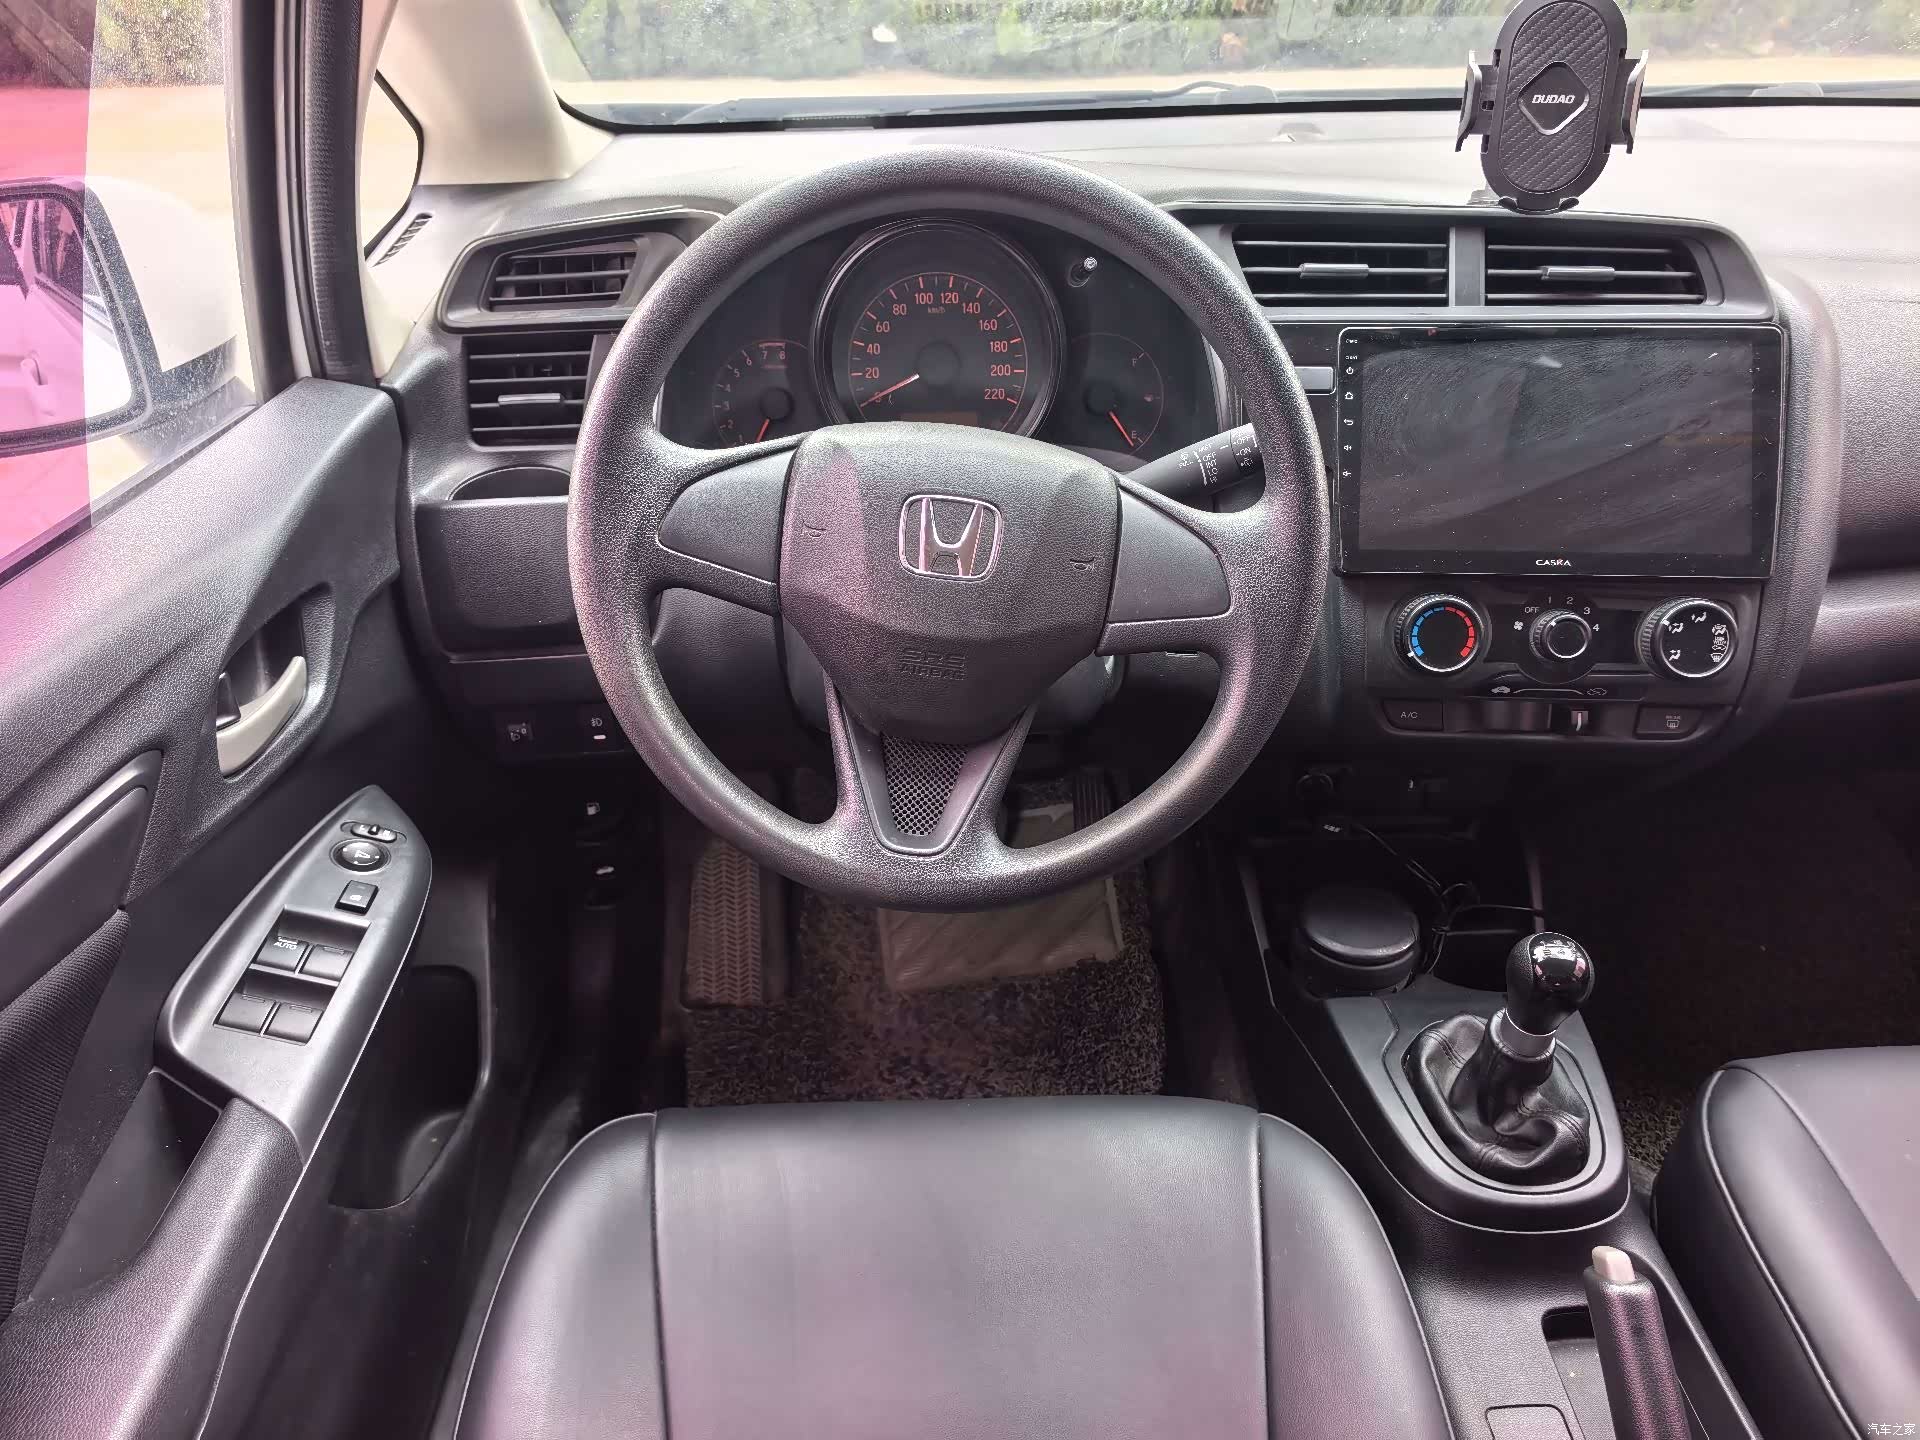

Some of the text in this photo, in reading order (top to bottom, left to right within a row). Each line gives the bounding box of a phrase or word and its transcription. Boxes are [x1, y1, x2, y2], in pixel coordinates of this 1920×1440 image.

[1531, 94, 1576, 104] DUDAO
[914, 292, 934, 305] 100
[940, 292, 959, 304] 120
[892, 303, 907, 316] 80
[962, 302, 981, 314] 140
[876, 321, 890, 333] 60
[979, 319, 998, 331] 160
[866, 343, 881, 355] 40
[989, 341, 1008, 353] 180
[865, 367, 880, 379] 20
[990, 364, 1011, 376] 200
[984, 388, 1006, 400] 220
[1535, 559, 1572, 567] CASKA
[1566, 596, 1574, 605] 2
[1524, 606, 1540, 614] OFF
[1583, 606, 1591, 615] 3
[1592, 623, 1600, 632] 4
[1400, 711, 1418, 719] A/C
